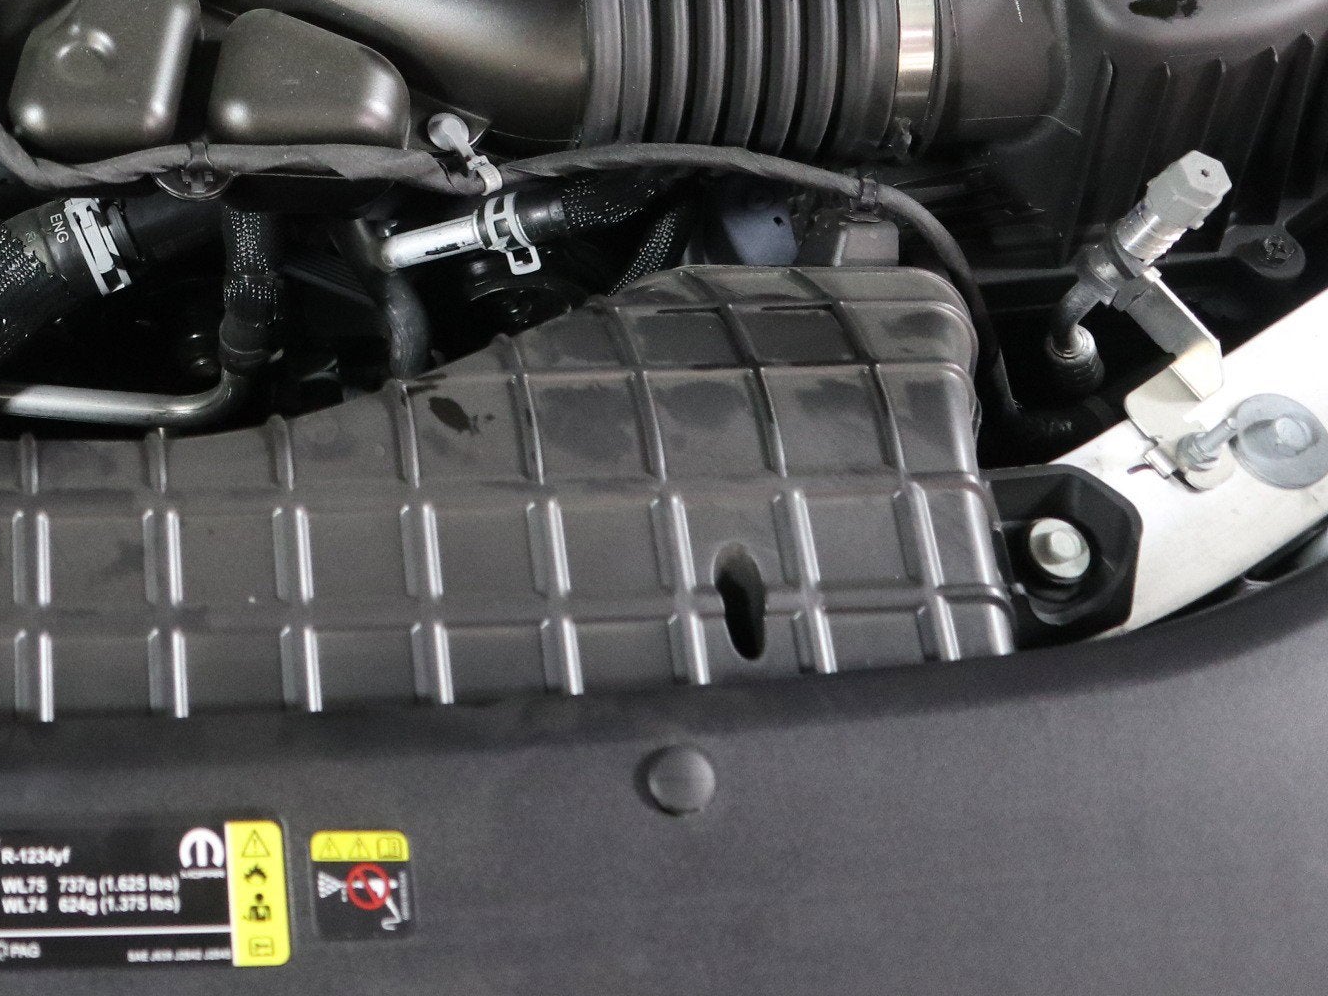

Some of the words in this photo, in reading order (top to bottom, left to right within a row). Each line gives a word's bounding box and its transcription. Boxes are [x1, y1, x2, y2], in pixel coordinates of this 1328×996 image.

[50, 213, 69, 243] ENG
[0, 846, 71, 867] R-1234yf
[0, 875, 48, 894] WL75
[57, 874, 98, 896] 737g
[99, 873, 148, 896] (1.625
[149, 873, 181, 895] lbs)
[1, 895, 48, 914] WL74
[58, 894, 98, 916] 624g
[100, 893, 149, 916] (1.375
[150, 893, 182, 914] lbs)
[9, 942, 41, 959] PAG
